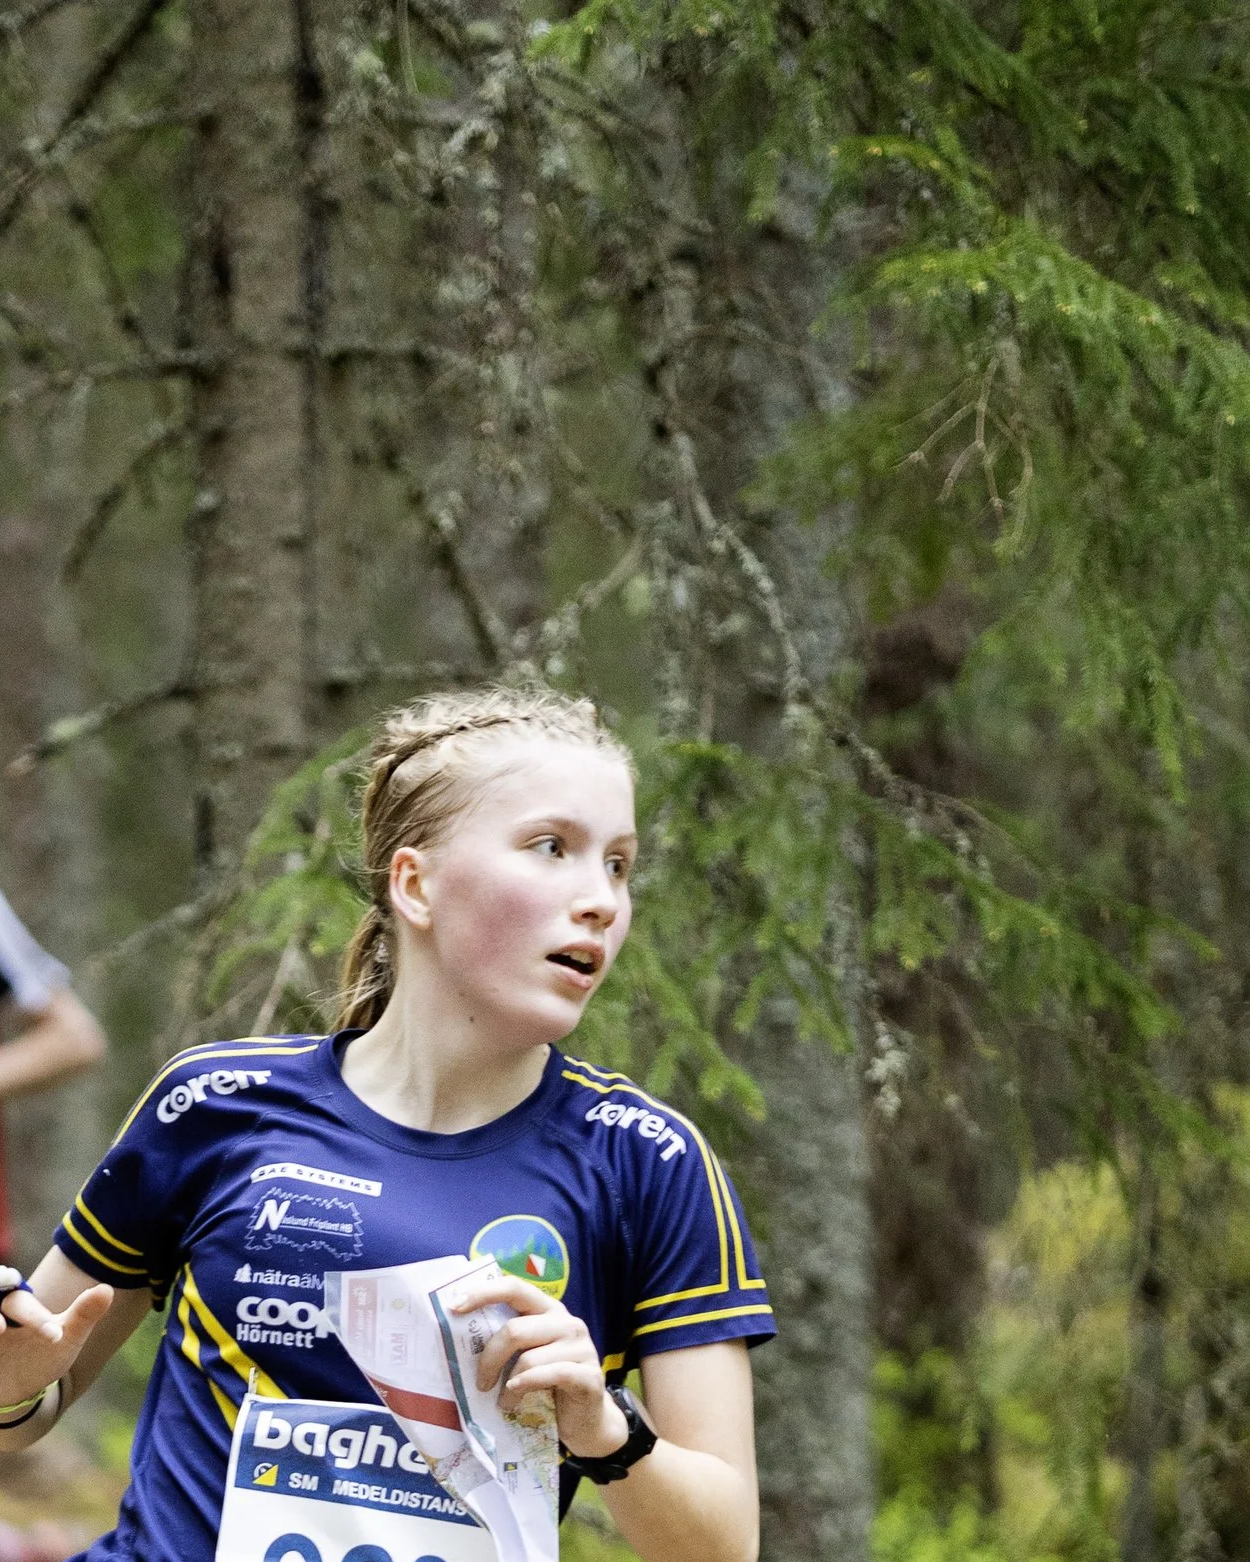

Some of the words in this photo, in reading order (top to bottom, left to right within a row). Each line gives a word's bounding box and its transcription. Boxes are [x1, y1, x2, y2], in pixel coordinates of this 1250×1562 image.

[296, 1169, 372, 1191] SYSTEMS
[236, 1323, 314, 1348] Hörnett
[288, 1472, 319, 1491] SM
[332, 1479, 467, 1516] MEDELDISTANS
